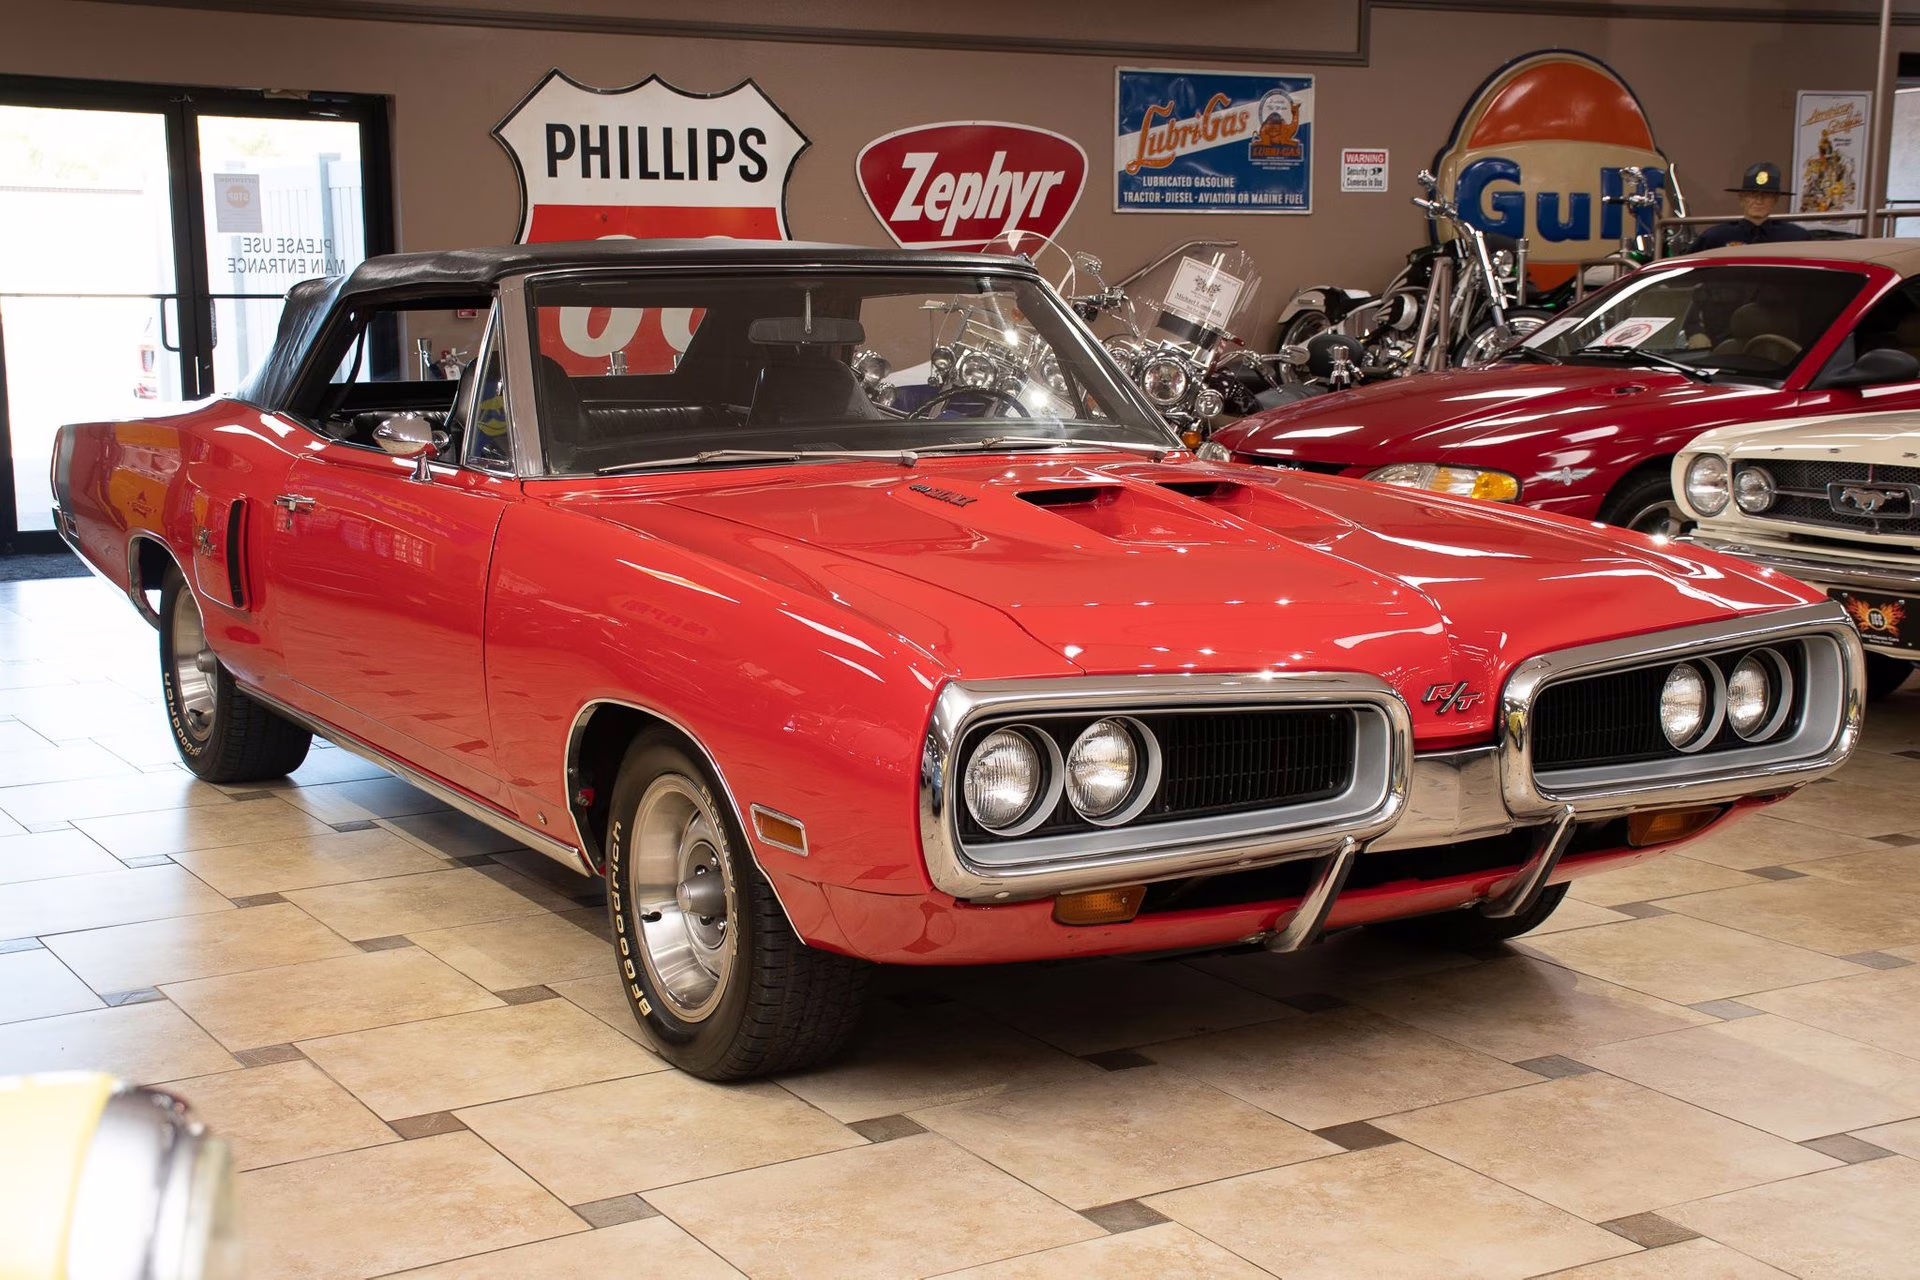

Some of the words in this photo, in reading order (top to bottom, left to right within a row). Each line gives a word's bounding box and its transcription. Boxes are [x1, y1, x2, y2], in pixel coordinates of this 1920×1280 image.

[545, 122, 769, 184] PHILLIPS
[1345, 153, 1385, 163] WARNING
[889, 150, 1066, 252] Zephyr
[1123, 192, 1160, 203] TRACTOR
[1165, 193, 1194, 203] DIESEL
[1198, 194, 1236, 204] AVIATION
[1237, 194, 1249, 204] OR
[1251, 194, 1283, 205] MARINE
[1284, 195, 1304, 205] FUEL
[1142, 175, 1192, 188] LUBRICATED
[1194, 176, 1235, 188] GASOLINE
[1455, 157, 1666, 242] Gulf
[1423, 682, 1481, 713] R/T
[611, 820, 653, 1018] BFGoodrich
